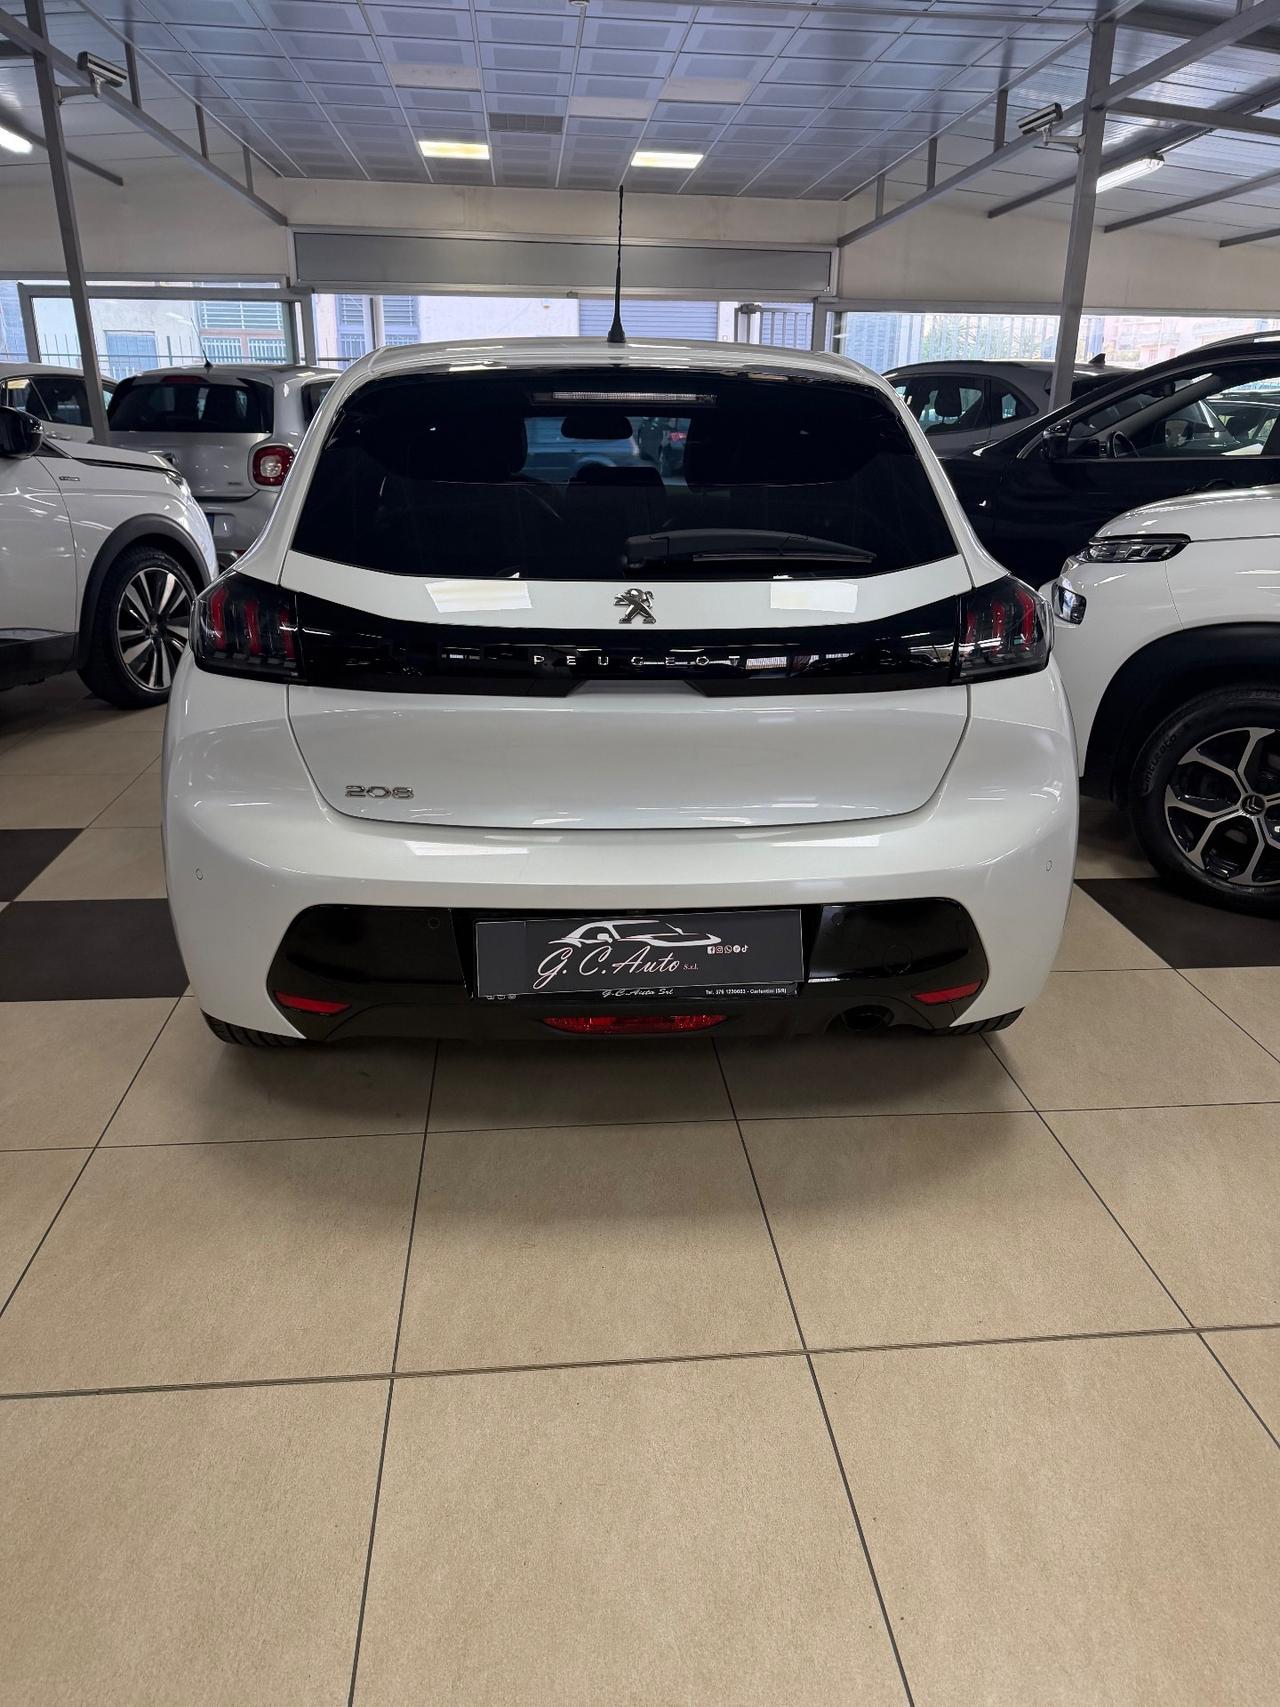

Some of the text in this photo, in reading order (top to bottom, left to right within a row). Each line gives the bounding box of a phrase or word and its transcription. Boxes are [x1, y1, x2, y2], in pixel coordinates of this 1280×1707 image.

[533, 655, 740, 667] PEUGEOT
[345, 785, 414, 799] 208
[612, 945, 680, 974] Auto
